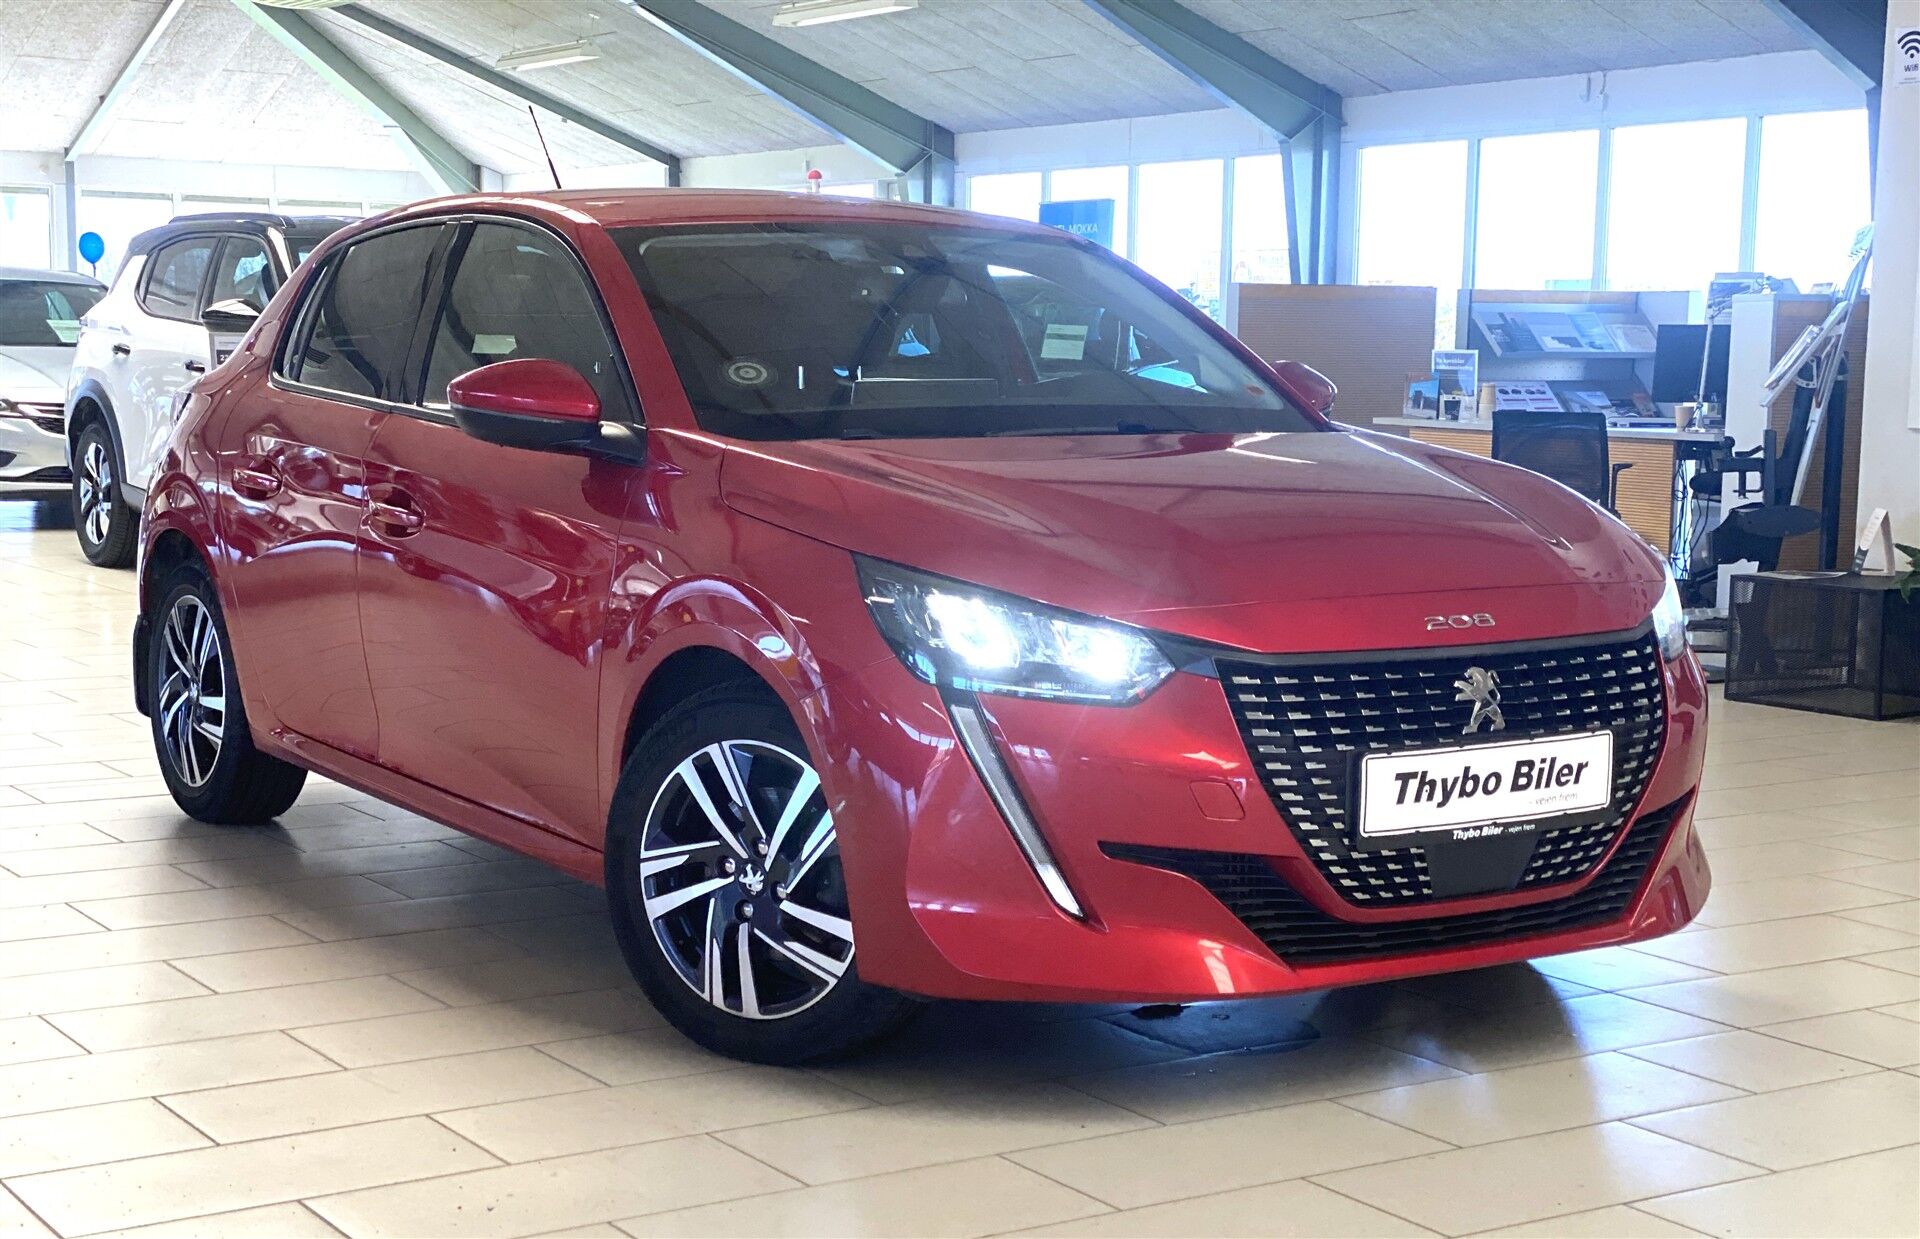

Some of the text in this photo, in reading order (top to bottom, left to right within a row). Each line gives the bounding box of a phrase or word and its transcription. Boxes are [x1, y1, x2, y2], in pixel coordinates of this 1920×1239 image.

[1068, 223, 1098, 234] MOKKA
[1424, 613, 1496, 631] 208
[1394, 756, 1589, 808] Thybo Biler
[1453, 828, 1480, 841] Thybo
[1481, 825, 1504, 837] Biler
